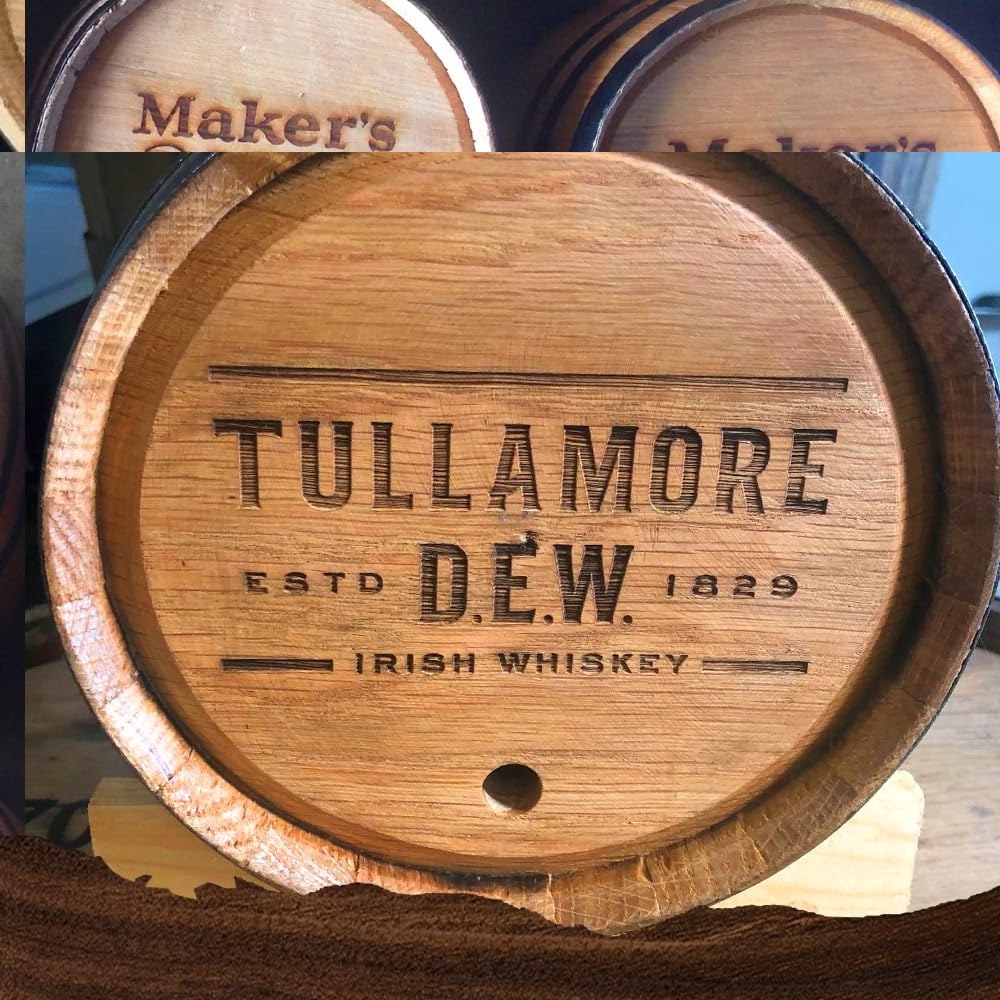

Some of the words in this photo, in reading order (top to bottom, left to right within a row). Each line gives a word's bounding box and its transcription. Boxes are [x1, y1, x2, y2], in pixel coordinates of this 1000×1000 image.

[132, 91, 397, 152] Maker's
[212, 418, 838, 516] TULLAMORE
[244, 570, 385, 595] ESTD
[666, 573, 799, 599] 1829
[355, 652, 477, 676] IRISH
[496, 651, 689, 676] WHISKEY
